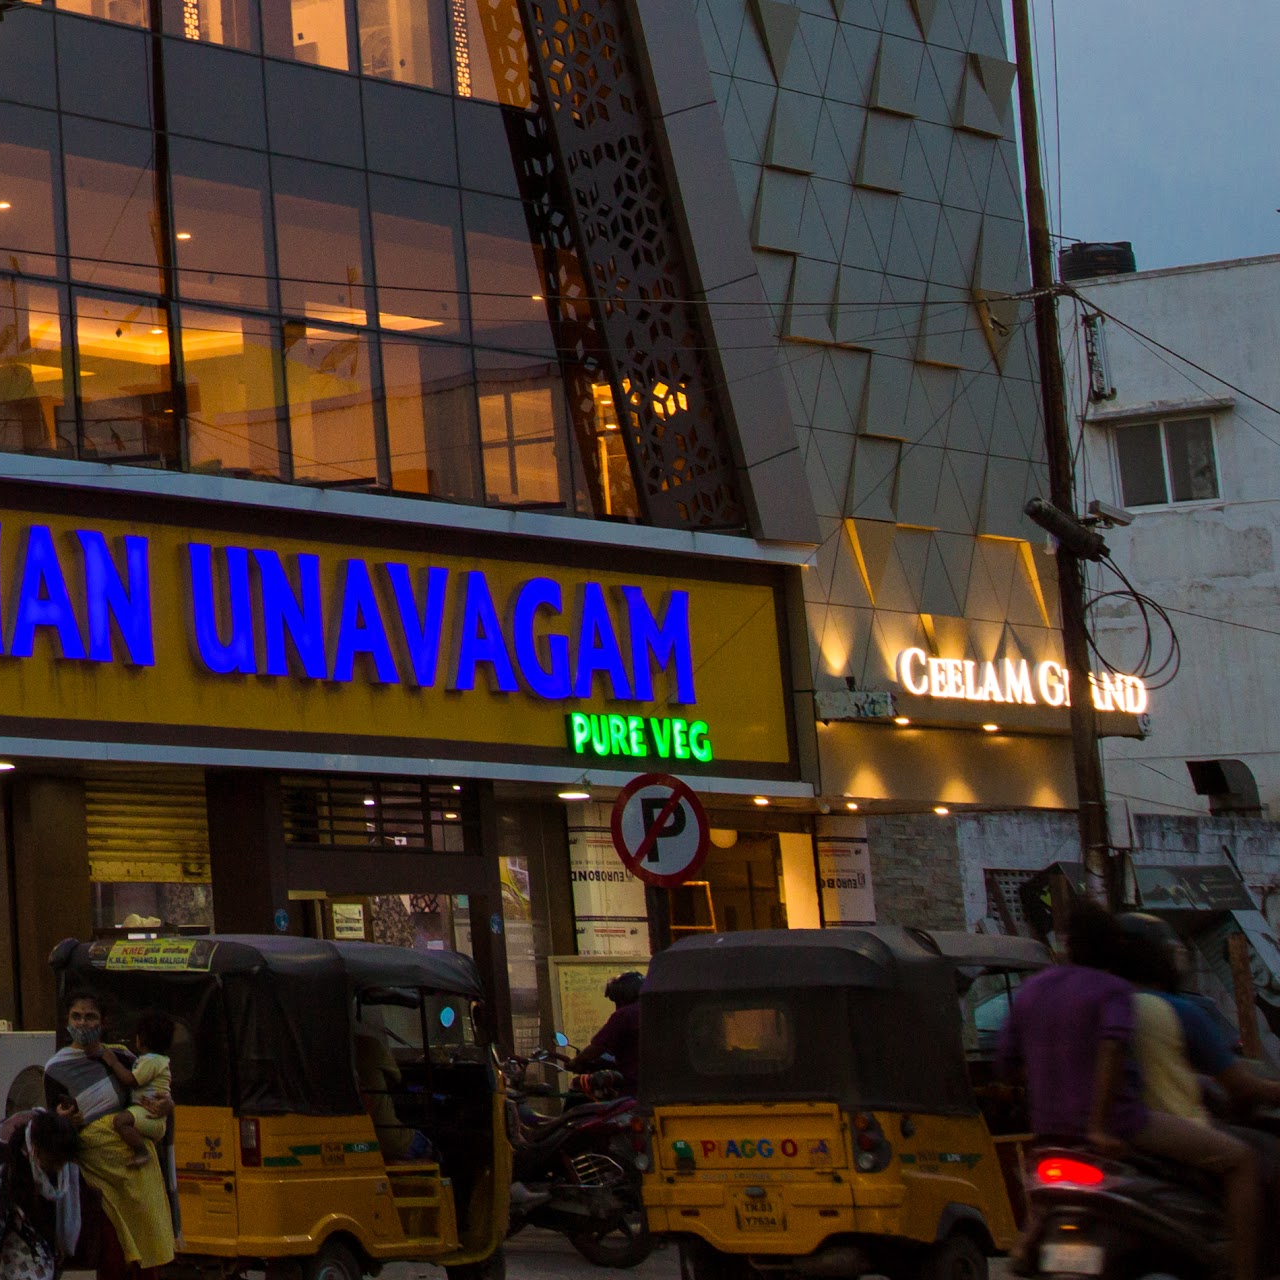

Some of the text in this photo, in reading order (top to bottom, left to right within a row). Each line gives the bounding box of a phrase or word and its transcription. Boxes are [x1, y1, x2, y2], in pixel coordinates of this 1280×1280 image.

[187, 542, 695, 704] UNAVAGAM
[898, 647, 1147, 714] CEELAM GND
[571, 712, 713, 762] PURE VEG
